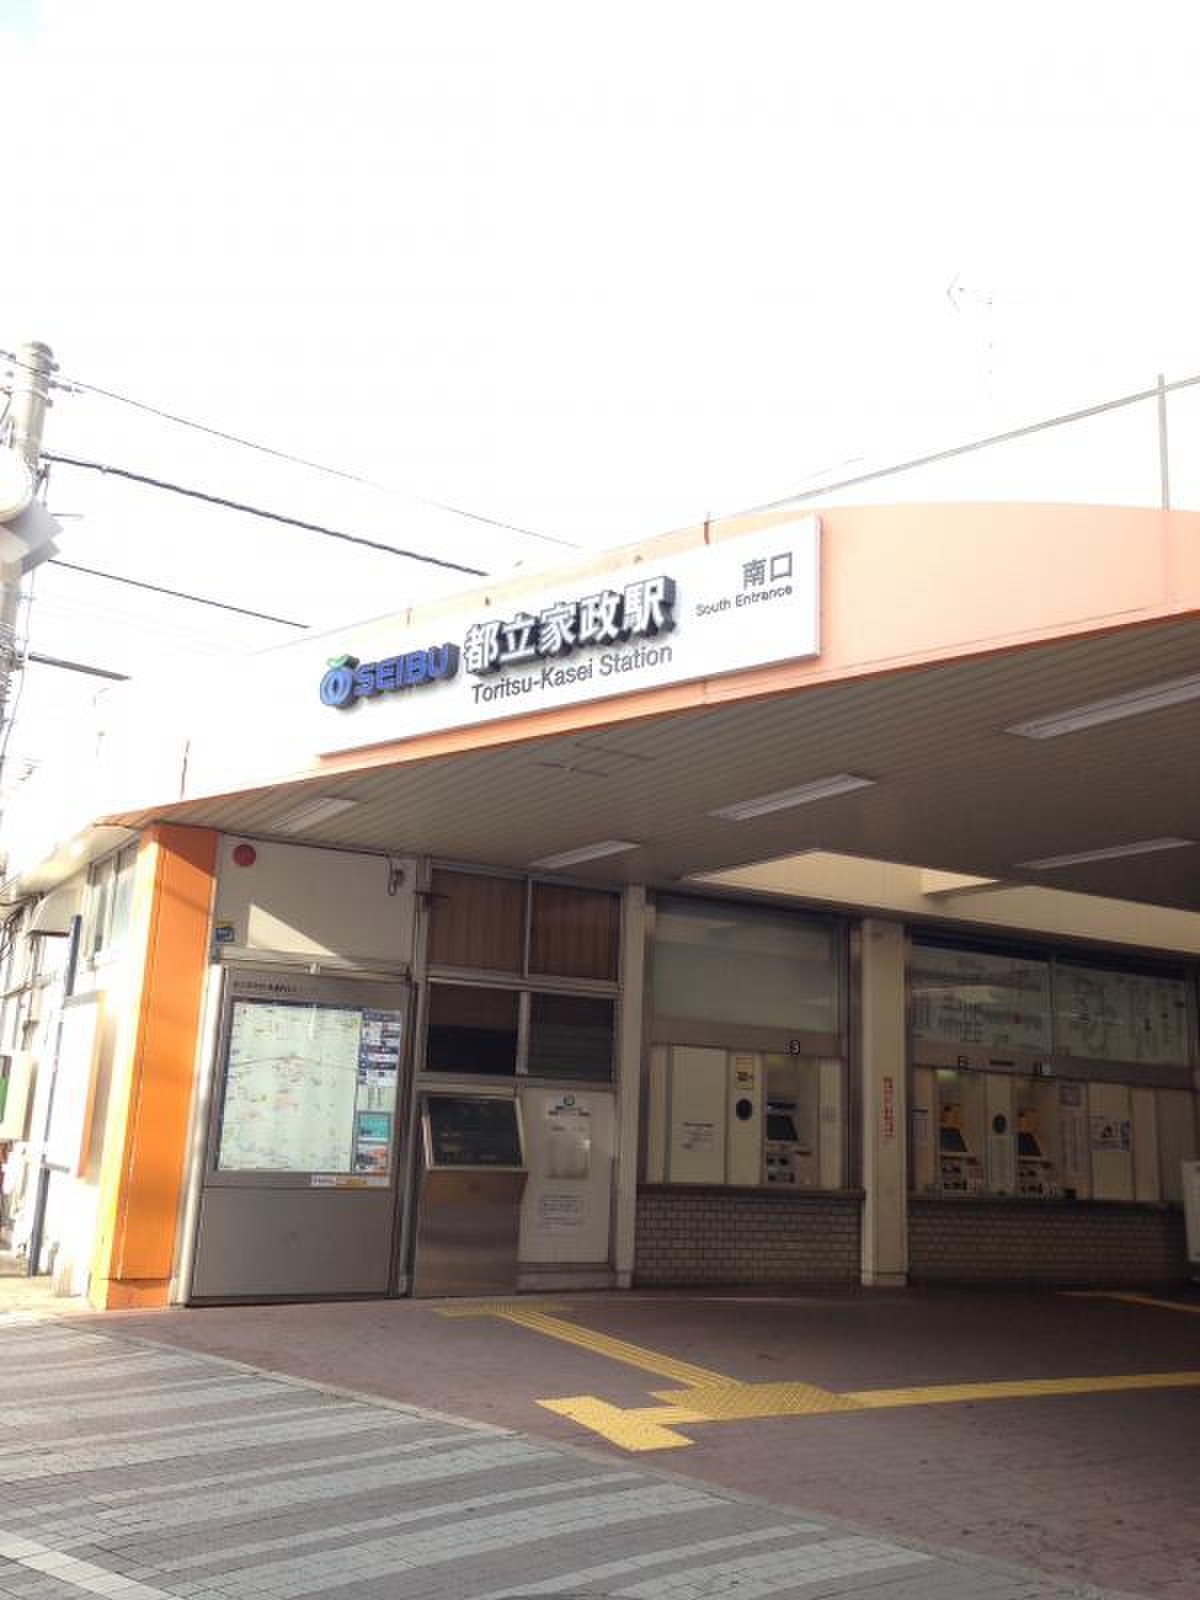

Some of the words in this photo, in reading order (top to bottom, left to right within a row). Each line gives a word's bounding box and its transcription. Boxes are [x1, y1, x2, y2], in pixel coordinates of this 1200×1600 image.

[742, 551, 792, 590] 南口
[464, 576, 672, 674] 都立家政駅
[695, 597, 731, 617] South
[735, 585, 793, 608] Entrance
[353, 643, 458, 697] SEIBU
[472, 659, 593, 704] Toritsu-Kasei
[600, 645, 673, 676] Station
